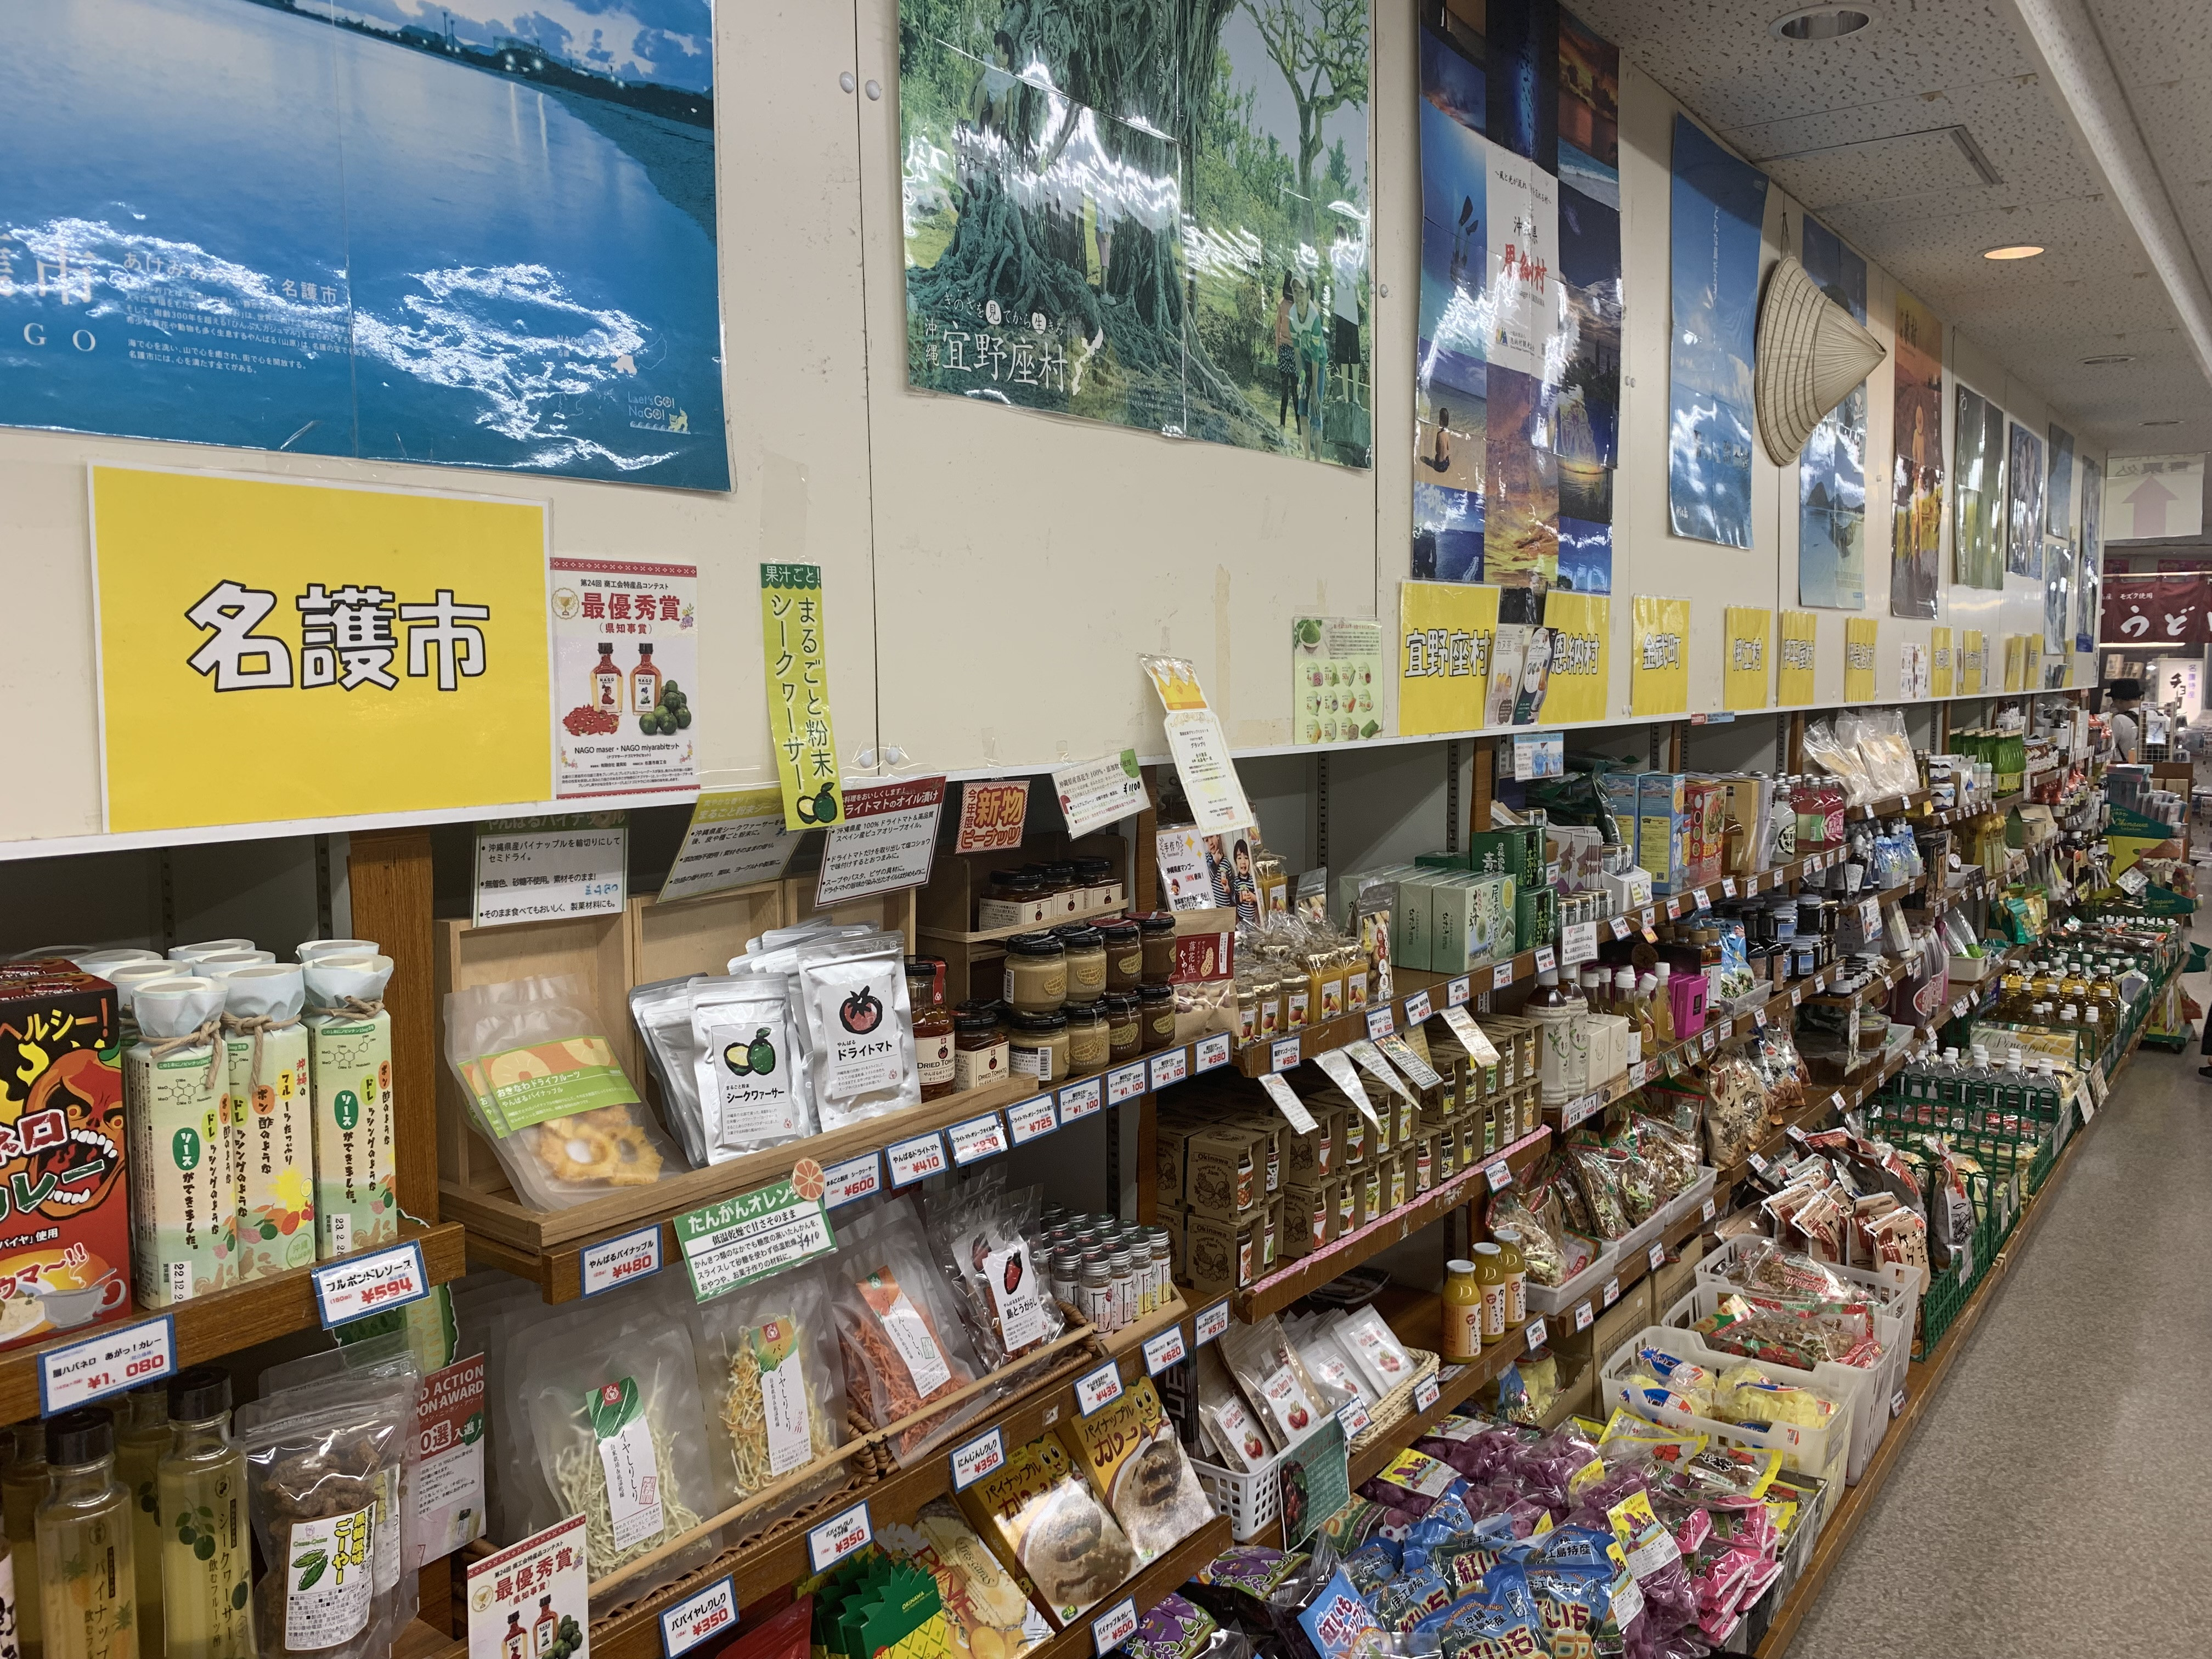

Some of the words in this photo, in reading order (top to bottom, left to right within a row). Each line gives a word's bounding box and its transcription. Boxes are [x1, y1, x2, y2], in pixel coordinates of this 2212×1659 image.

[281, 279, 338, 303] 名護市
[924, 318, 940, 367] 沖縄
[129, 350, 257, 374] 名護市には、心を満たす全てがある。
[943, 321, 1069, 393] 宜野座村
[580, 579, 602, 588] 第24回
[604, 579, 669, 591] 商工会特産品コンテスト
[581, 592, 681, 622] 最優秀賞
[184, 579, 490, 692] 名護市
[1404, 628, 1491, 678] 宜野座村
[1551, 632, 1600, 675] 恩納村
[1642, 633, 1681, 670] 金武町
[771, 594, 804, 790] シークワーサー
[799, 597, 833, 778] まるごと粉末
[843, 787, 905, 803] 料理をおいしくします!
[844, 789, 939, 815] ライトマトのオイル漬け
[1124, 781, 1141, 795] ¥1100
[964, 789, 977, 829] 今年度
[977, 787, 1025, 828] 新物
[488, 836, 620, 853] 沖縄県産パイナップルを輪切りにして
[961, 826, 1022, 849] ピーナッツ
[1164, 839, 1181, 852] 手作り
[488, 853, 532, 864] セミドライ。
[830, 854, 900, 871] で味付けするとおつまみに。
[826, 865, 905, 886] スープやパスタ、ピザの具材に。
[484, 900, 616, 918] そのまま食べてもおいしく、製菓材料にも。
[1187, 940, 1197, 974] 落花生
[837, 1040, 893, 1062] ドライトマト
[1208, 1052, 1226, 1065] ¥380
[1282, 1055, 1297, 1065] ¥920
[496, 1070, 581, 1097] おきなわドライフルーツ
[978, 1073, 991, 1081] DRIED
[991, 1067, 1007, 1077] TOMATO
[502, 1086, 563, 1108] やんばるパイナップル
[726, 1088, 785, 1104] シークワァーサー
[257, 1088, 275, 1175] ポン酢のような
[281, 1074, 292, 1166] フルーツたっぷり
[1029, 1116, 1053, 1134] ¥725
[341, 1094, 357, 1204] ソースができました。
[366, 1078, 377, 1192] ドレッシングのような
[233, 1099, 250, 1218] ドレッシングのような
[893, 1144, 939, 1164] やんばるドライトマト
[912, 1156, 940, 1173] ¥410
[1198, 1153, 1229, 1165] Okinawa
[206, 1113, 219, 1235] ドレッシングのような
[844, 1177, 875, 1197] ¥600
[179, 1132, 198, 1250] ソースができました。
[687, 1186, 803, 1234] たんかんオレン
[712, 1209, 797, 1246] 低温乾燥で甘さそのまま
[798, 1231, 821, 1251] ¥410
[1196, 1224, 1227, 1238] Okinawa
[589, 1240, 654, 1268] やんばるパイナップル
[694, 1218, 820, 1269] かんきつ類のなかでも糖度の高いたんかんを、
[1206, 1240, 1218, 1249] Jam
[612, 1255, 652, 1278] ¥480
[697, 1240, 800, 1280] スライスして砂糖を使わず低温乾燥。
[700, 1254, 792, 1291] おやつや、お菓子作りの材料に。
[360, 1277, 413, 1305] ¥594
[1003, 1295, 1026, 1307] やんばる生まれの
[1006, 1298, 1038, 1320] 島とうがらし
[1208, 1319, 1225, 1335] ¥570
[1161, 1345, 1181, 1363] ¥620
[87, 1354, 164, 1389] ¥1,080
[433, 1363, 484, 1397] ACTION
[439, 1380, 485, 1409] AWARD
[1095, 1383, 1118, 1401] ¥435
[1085, 1404, 1135, 1443] パイナップル
[958, 1439, 997, 1469] にんじんしりしり
[1093, 1425, 1138, 1468] カレー
[974, 1452, 999, 1474] ¥350
[985, 1455, 1042, 1504] パイナップル
[331, 1517, 353, 1585] ごーやー
[351, 1510, 366, 1566] 黒糖風味
[835, 1528, 865, 1554] ¥350
[494, 1564, 511, 1578] 第24回
[512, 1541, 564, 1569] 商工会特産品コンテスト
[218, 1513, 233, 1641] シークワーサー
[495, 1547, 573, 1602] 最優秀賞
[208, 1559, 222, 1646] 飲むフルーツ酢
[672, 1592, 727, 1631] パパイヤしりしり
[901, 1590, 925, 1610] OKINAWA
[692, 1607, 729, 1636] ¥350
[1097, 1608, 1132, 1637] パイナップルカレー
[1110, 1620, 1133, 1640] ¥500
[1317, 1594, 1353, 1647] 紅いも
[1462, 1609, 1486, 1626] 沖縄
